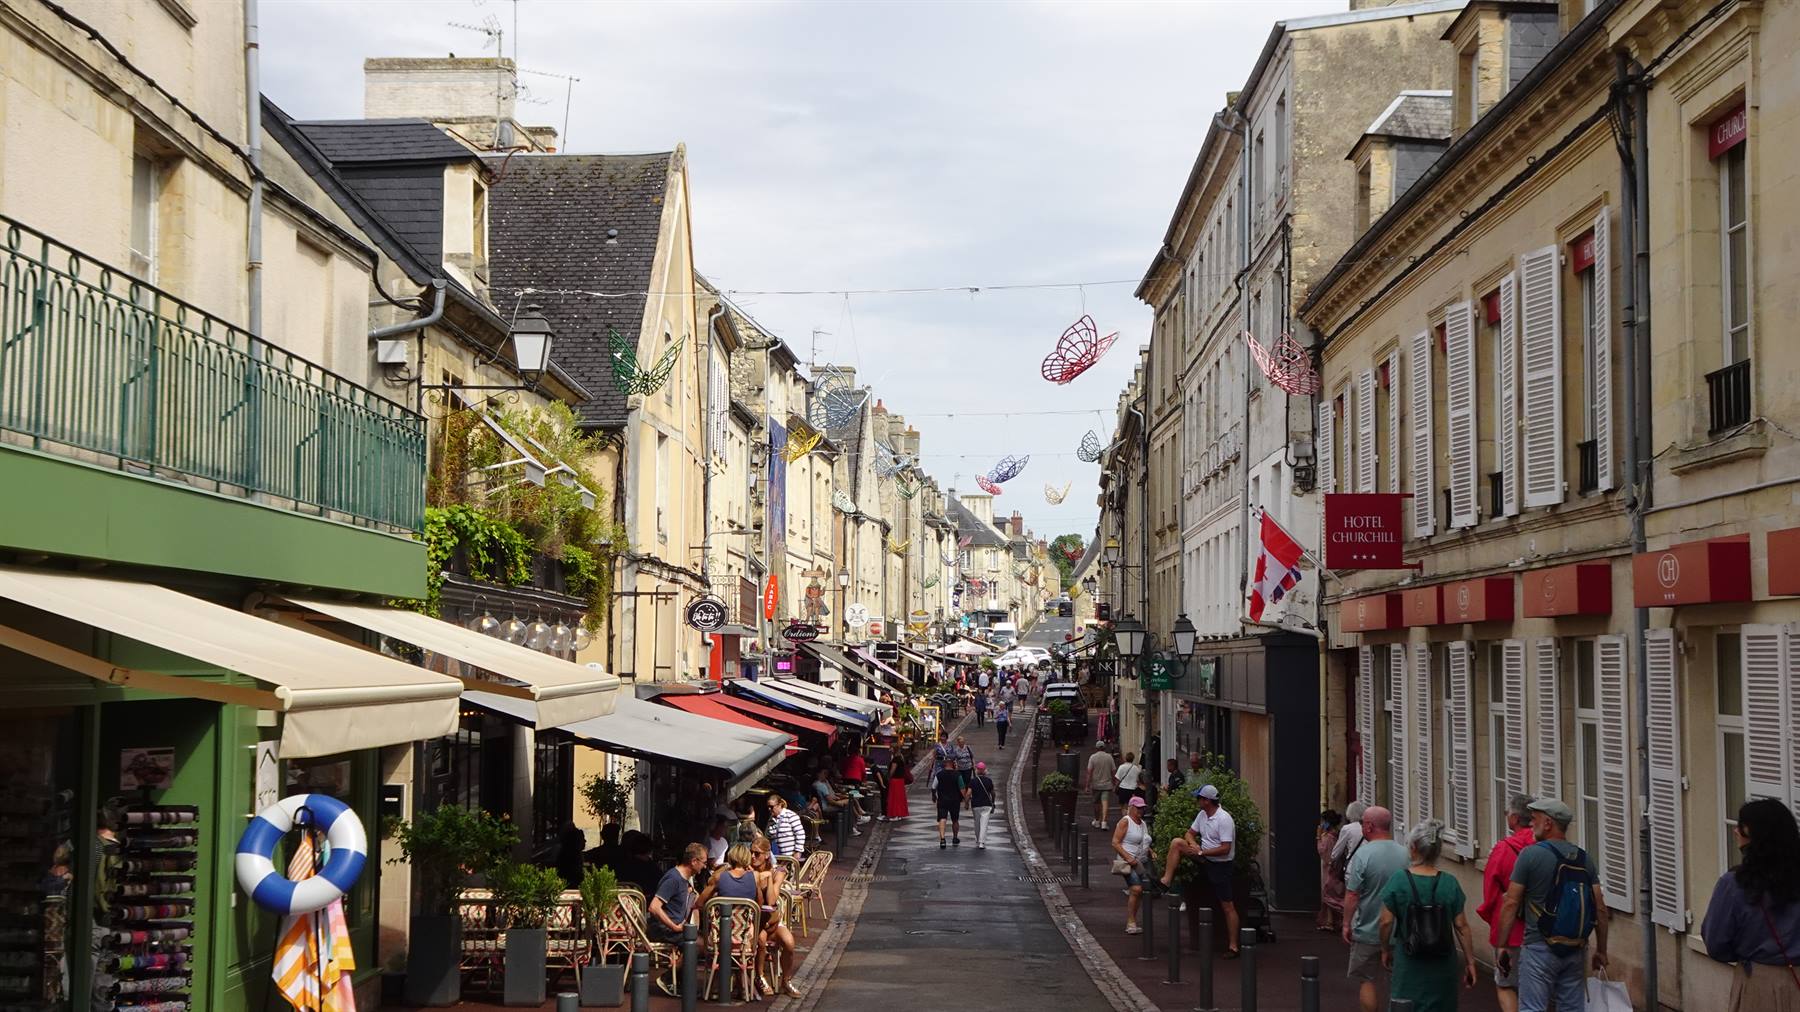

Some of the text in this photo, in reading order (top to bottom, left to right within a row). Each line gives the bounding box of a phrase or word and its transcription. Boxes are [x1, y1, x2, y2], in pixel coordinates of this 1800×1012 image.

[1344, 516, 1384, 528] HOTEL
[1332, 532, 1396, 543] CHURCHILL
[1661, 559, 1675, 581] CH
[767, 584, 775, 610] TABAC
